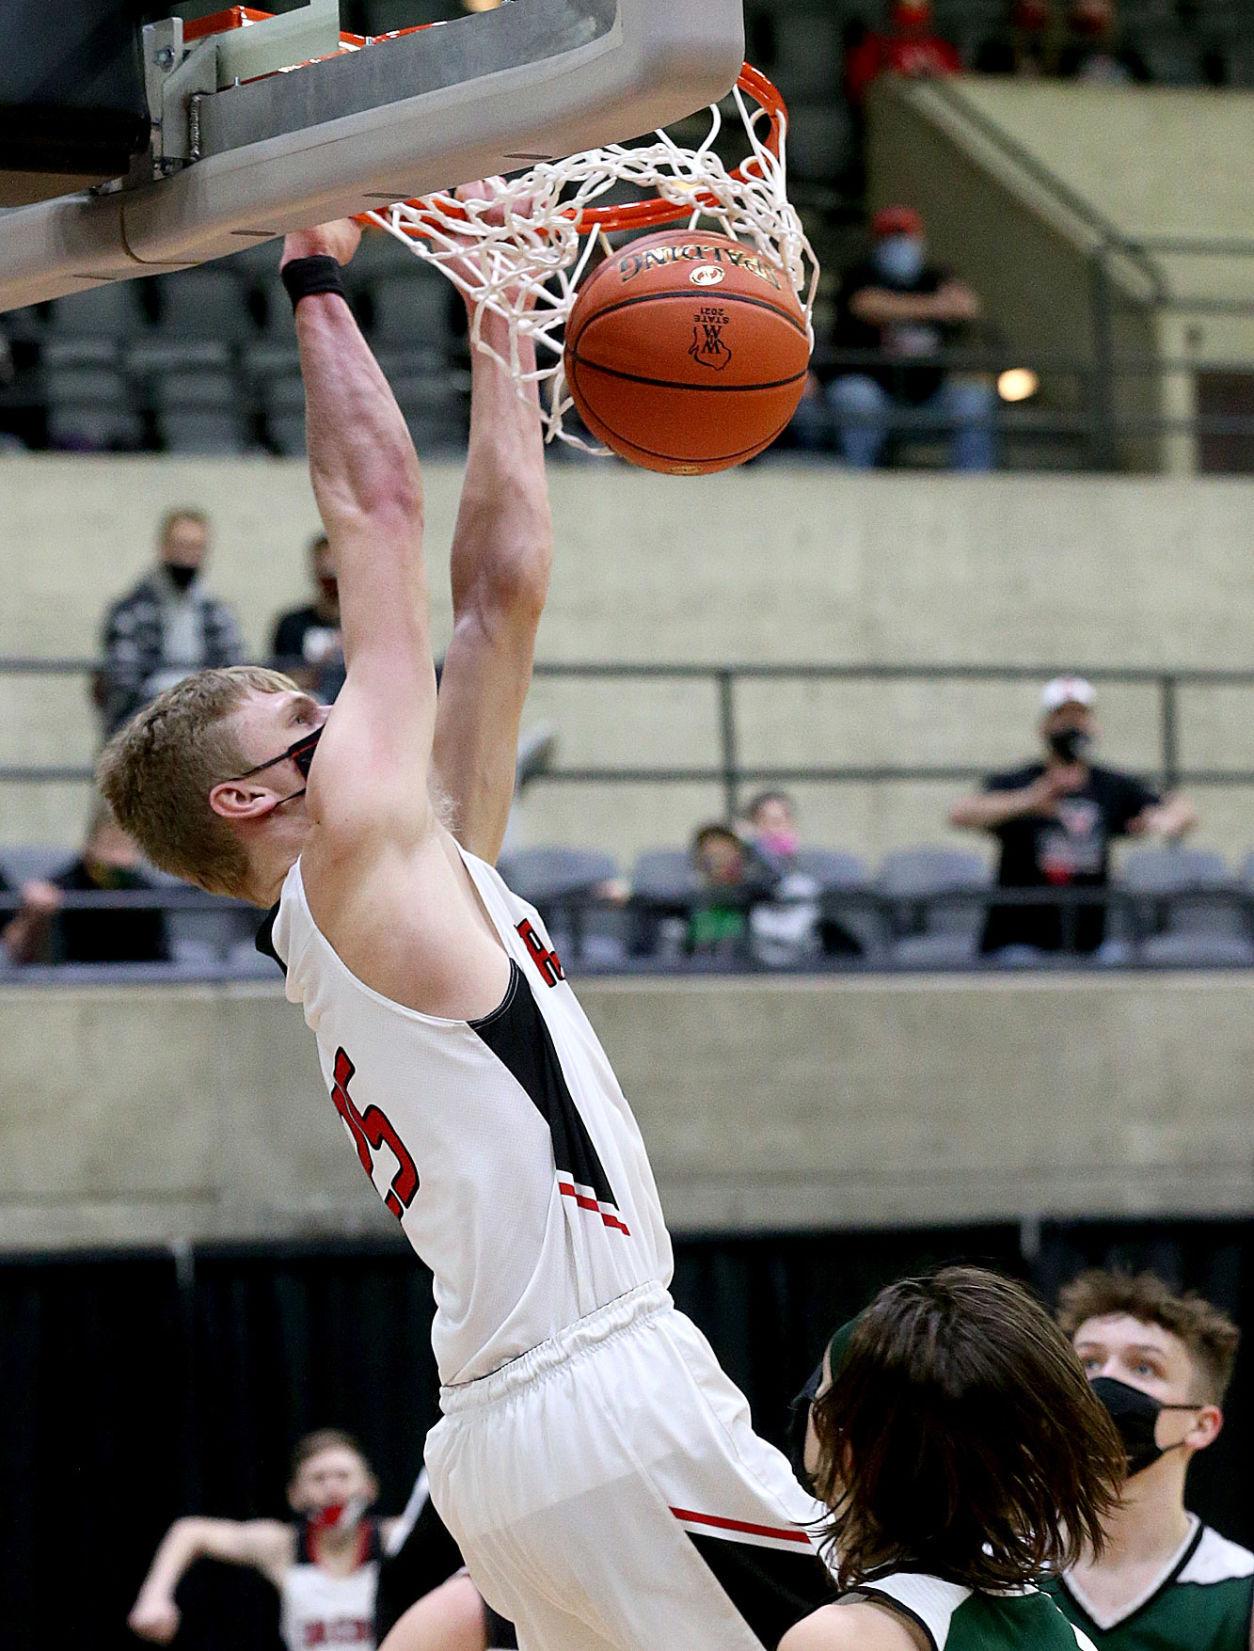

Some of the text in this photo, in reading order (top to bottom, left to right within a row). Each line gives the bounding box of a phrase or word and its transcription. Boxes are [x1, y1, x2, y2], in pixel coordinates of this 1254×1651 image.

[618, 243, 782, 291] SPALDING
[700, 306, 725, 316] 2021
[693, 314, 730, 325] STATE
